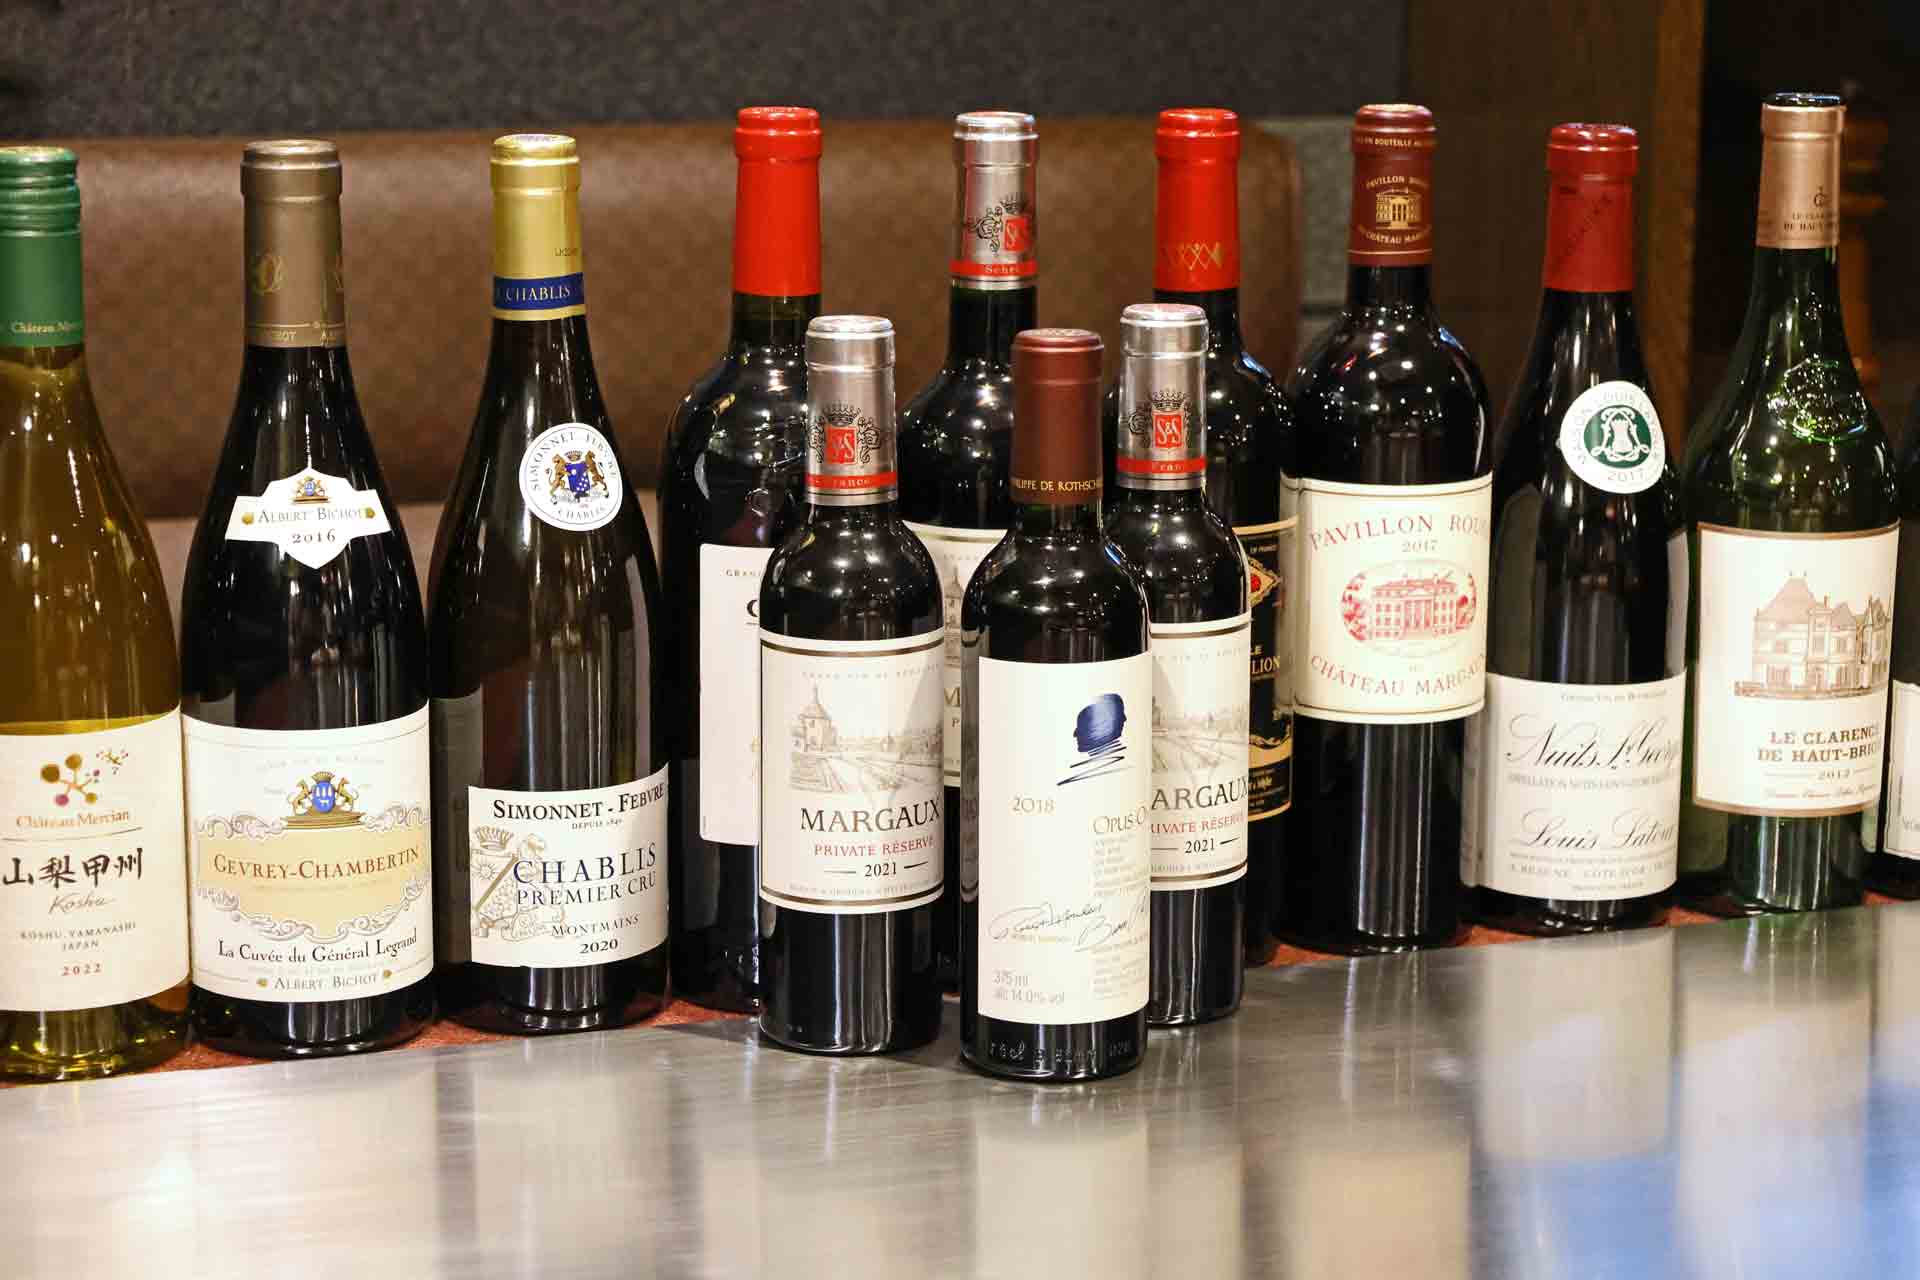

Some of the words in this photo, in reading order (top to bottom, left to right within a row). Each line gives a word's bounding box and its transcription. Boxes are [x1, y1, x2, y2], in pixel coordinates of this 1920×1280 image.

[505, 285, 571, 301] CHABLIS
[1040, 480, 1055, 491] DE
[258, 508, 308, 525] ALBERT
[317, 506, 368, 522] BICHOT
[292, 528, 336, 544] 2016
[1310, 513, 1433, 551] PAVILLON
[1401, 539, 1438, 553] 2017
[1768, 730, 1796, 745] LE
[1757, 749, 1783, 761] DE
[493, 799, 604, 821] SIMONNET
[617, 782, 666, 813] FEBVRE
[1151, 776, 1248, 811] ARGAUX
[1011, 794, 1056, 813] 2018
[79, 809, 130, 825] Mercian
[572, 819, 604, 831] DEPUIS
[800, 799, 941, 833] MARGAUX
[814, 844, 877, 858] PRIVATE
[1184, 837, 1216, 854] 2021
[2, 846, 144, 889] 山梨甲州
[213, 845, 420, 880] GEVREY-CHAMBERTIN
[513, 842, 656, 884] CHABLIS
[864, 861, 898, 879] 2021
[518, 883, 622, 905] PREMIER
[627, 870, 657, 896] CRU
[48, 889, 118, 915] Koshu
[69, 921, 137, 939] YAMANASHI
[551, 913, 640, 937] MONTMAINS
[62, 939, 99, 951] JAPAN
[218, 940, 235, 960] La
[239, 942, 285, 964] Cuvée
[287, 948, 307, 963] du
[311, 942, 370, 964] Général
[375, 927, 418, 956] Legrand
[580, 938, 619, 955] 2020
[61, 962, 101, 977] 2022
[274, 976, 323, 991] ALBERT
[332, 973, 378, 990] BICHOT
